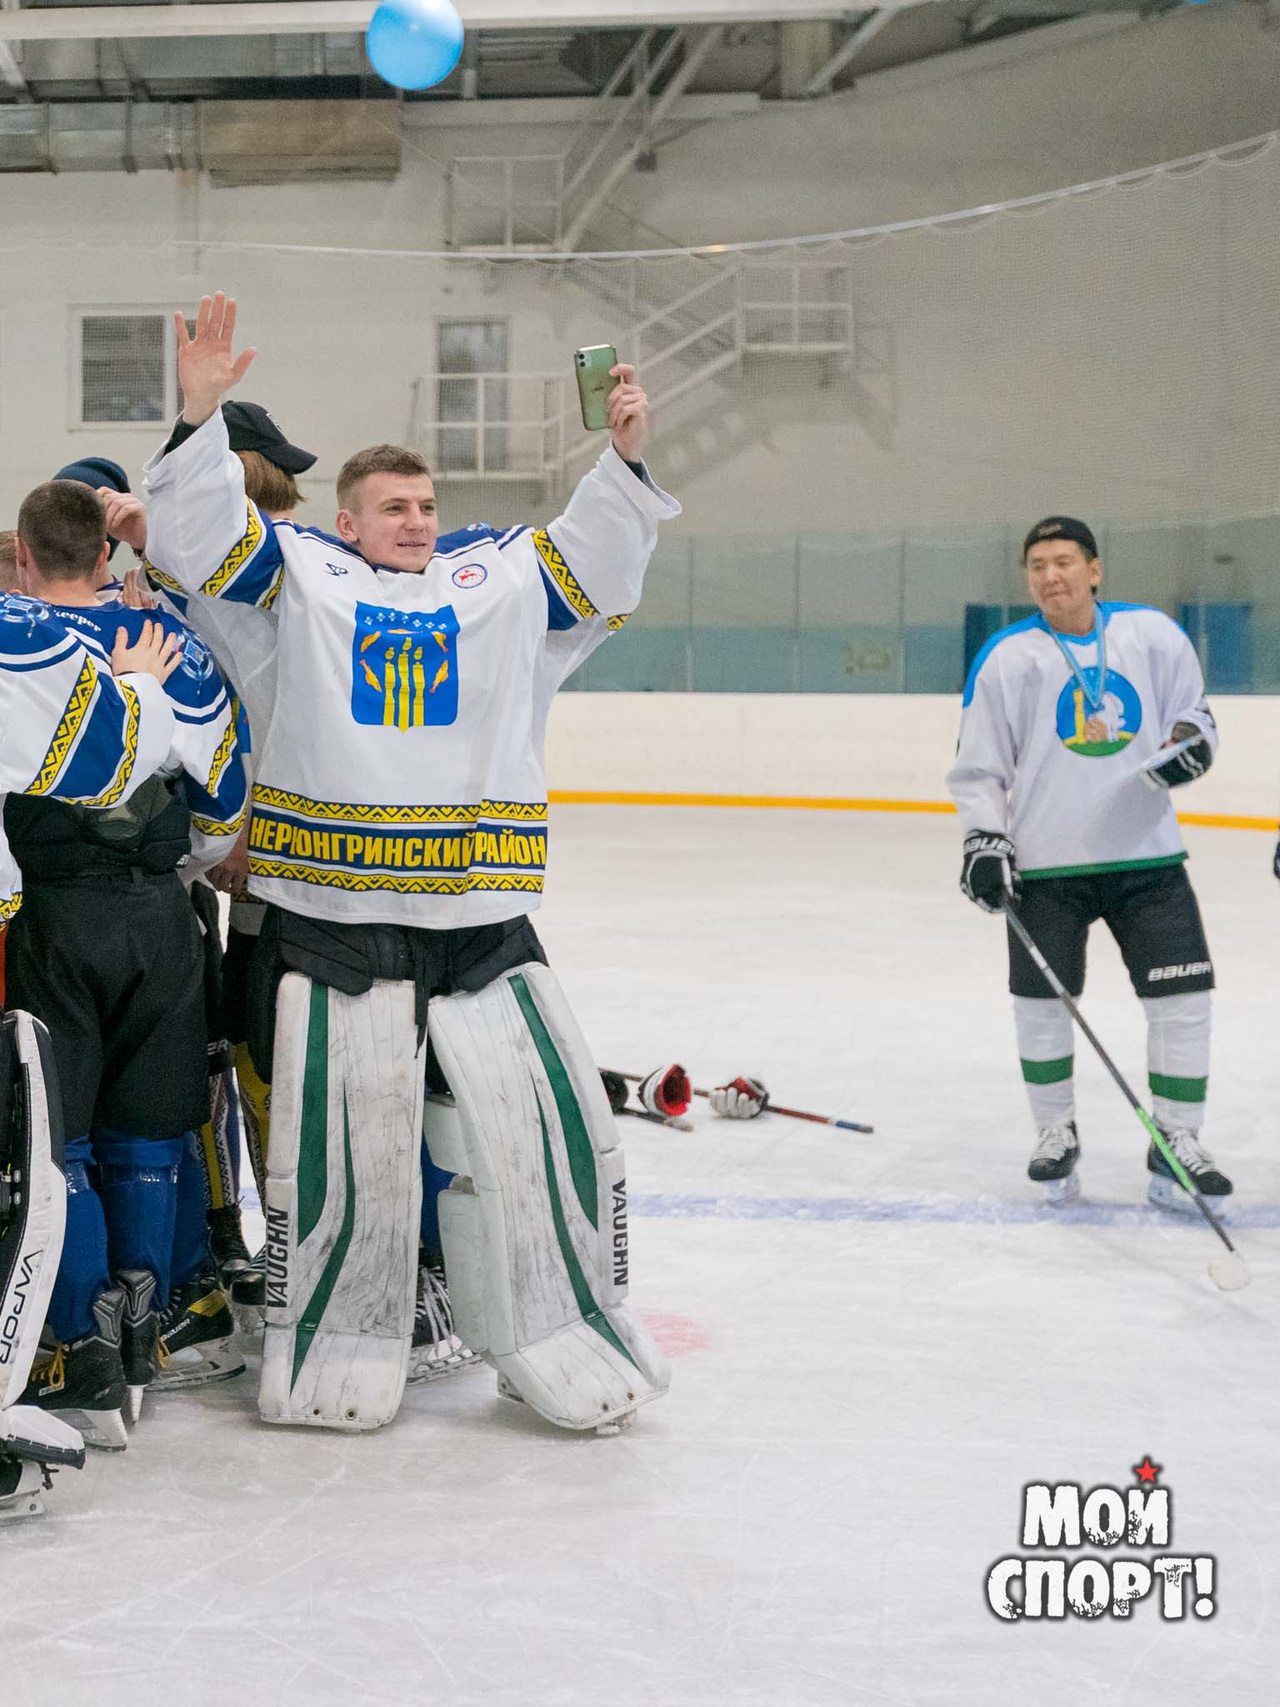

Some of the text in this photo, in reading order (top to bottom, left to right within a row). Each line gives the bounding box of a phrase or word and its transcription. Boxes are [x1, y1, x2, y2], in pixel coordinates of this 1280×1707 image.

[248, 815, 547, 869] НЕРЮНГРИНСКИЙ РАЙОН
[963, 836, 1015, 854] AUE
[1148, 961, 1211, 982] BAUER
[266, 1204, 289, 1308] VAUGHN
[611, 1177, 629, 1286] VAUGHN
